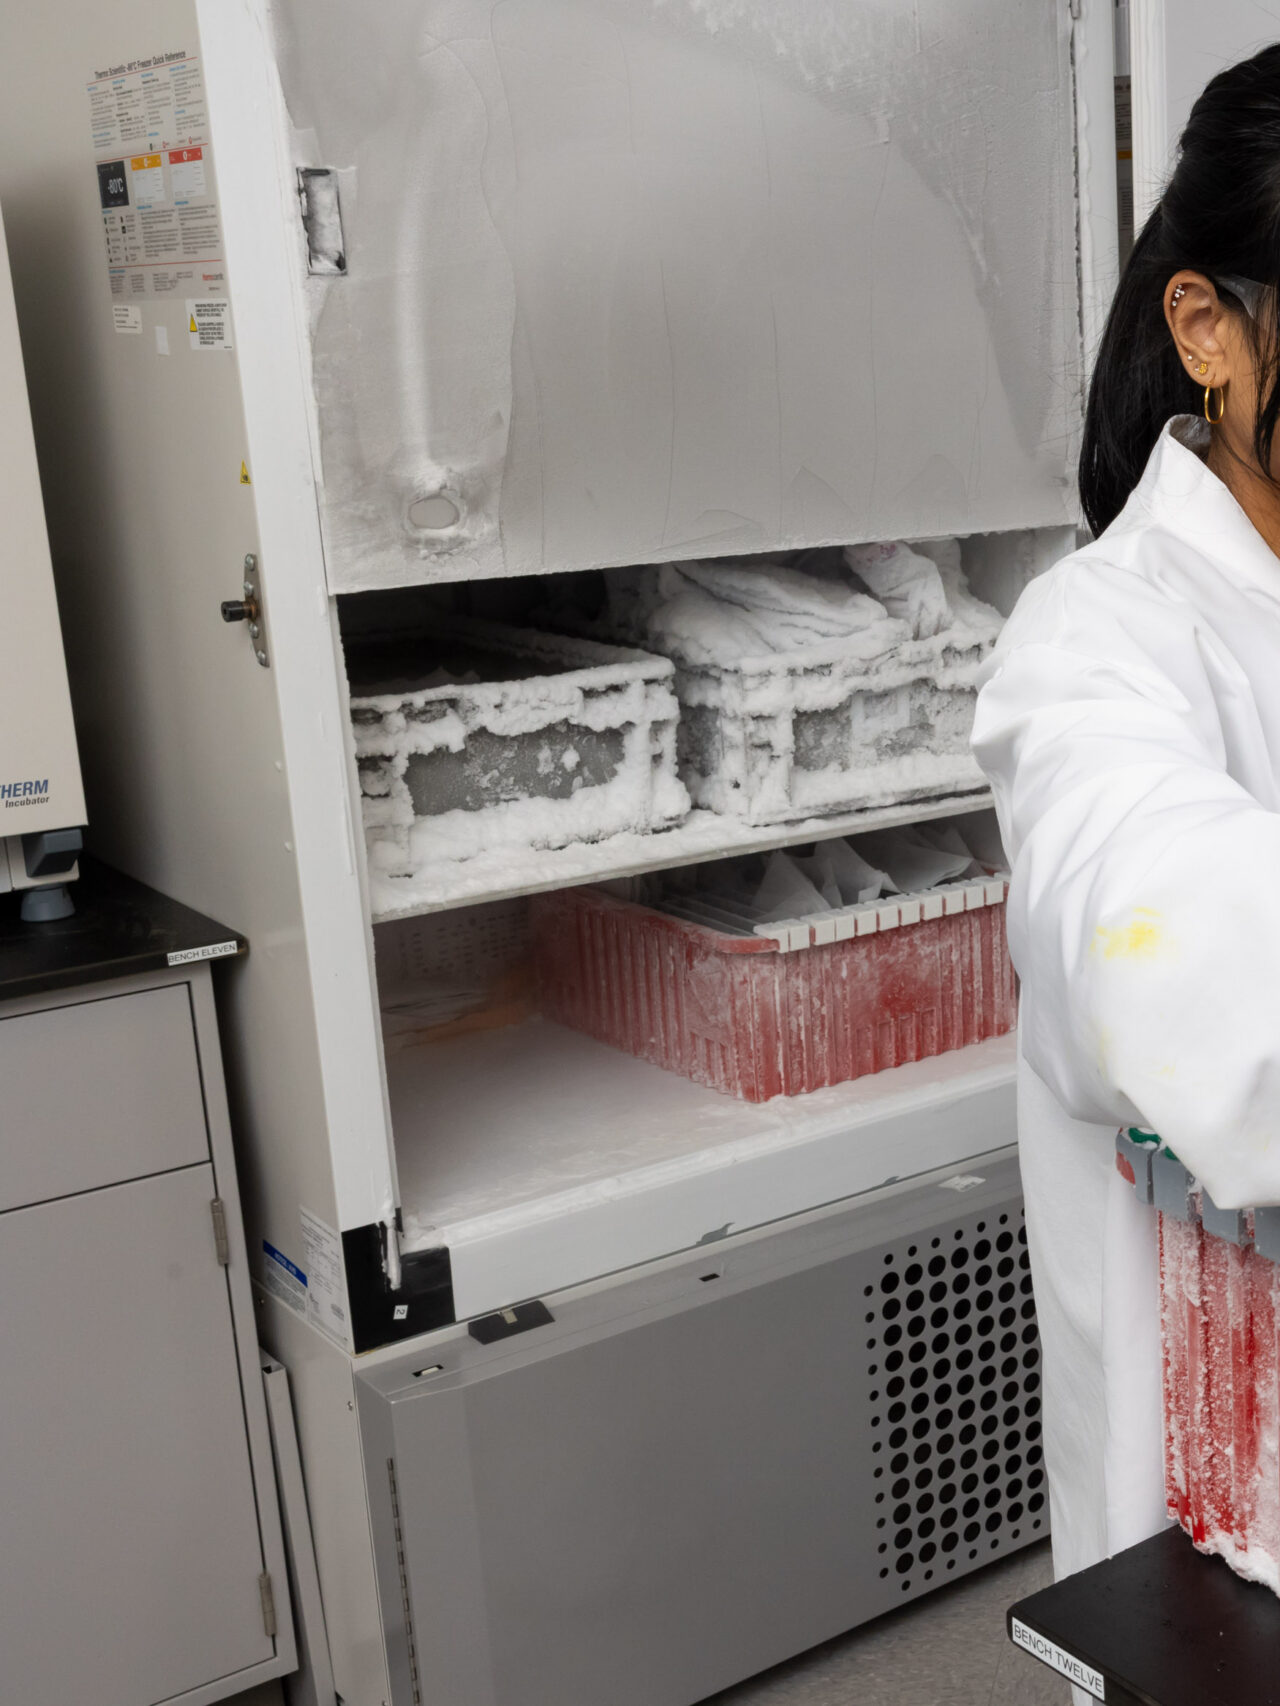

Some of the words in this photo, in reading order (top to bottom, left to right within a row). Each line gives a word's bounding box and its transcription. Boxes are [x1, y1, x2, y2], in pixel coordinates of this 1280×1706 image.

[0, 779, 49, 799] HERM
[5, 797, 50, 808] Incubator
[168, 950, 200, 963] BENCH
[201, 943, 237, 957] ELEVEN
[1014, 1624, 1053, 1660] BENCH
[1054, 1651, 1103, 1693] TWELVE
